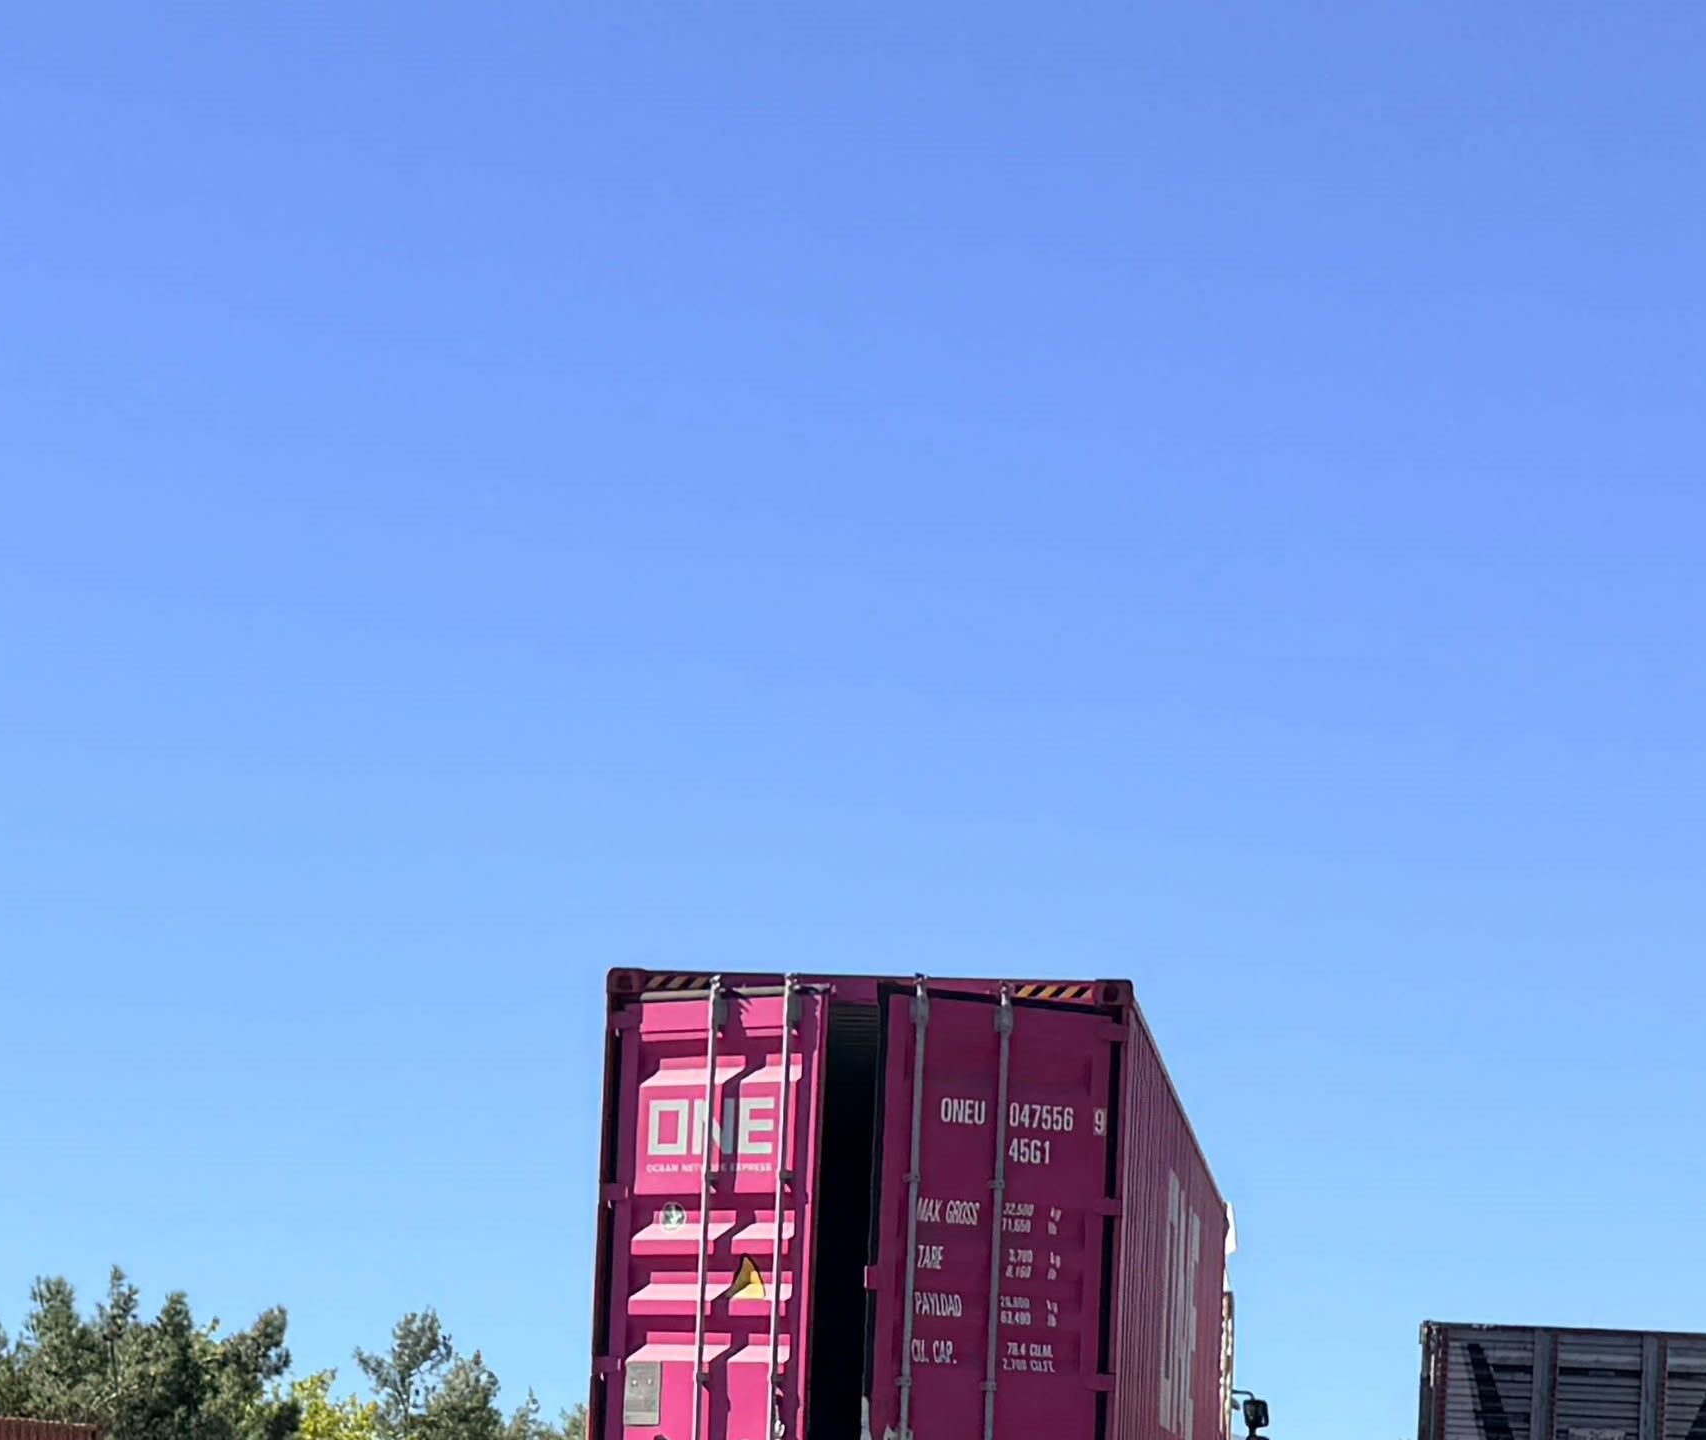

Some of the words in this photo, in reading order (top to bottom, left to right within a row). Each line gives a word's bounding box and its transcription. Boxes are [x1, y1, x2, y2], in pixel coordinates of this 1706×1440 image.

[647, 1097, 775, 1156] ONE
[940, 1097, 986, 1125] ONEU
[1009, 1102, 1074, 1132] 047556
[1094, 1108, 1106, 1134] 9
[1008, 1137, 1051, 1165] 45G1
[916, 1197, 941, 1223] MAX
[945, 1200, 980, 1226] GROSS
[917, 1245, 944, 1270] TARE
[914, 1291, 963, 1317] PAYLOAD
[933, 1340, 958, 1364] CAP.
